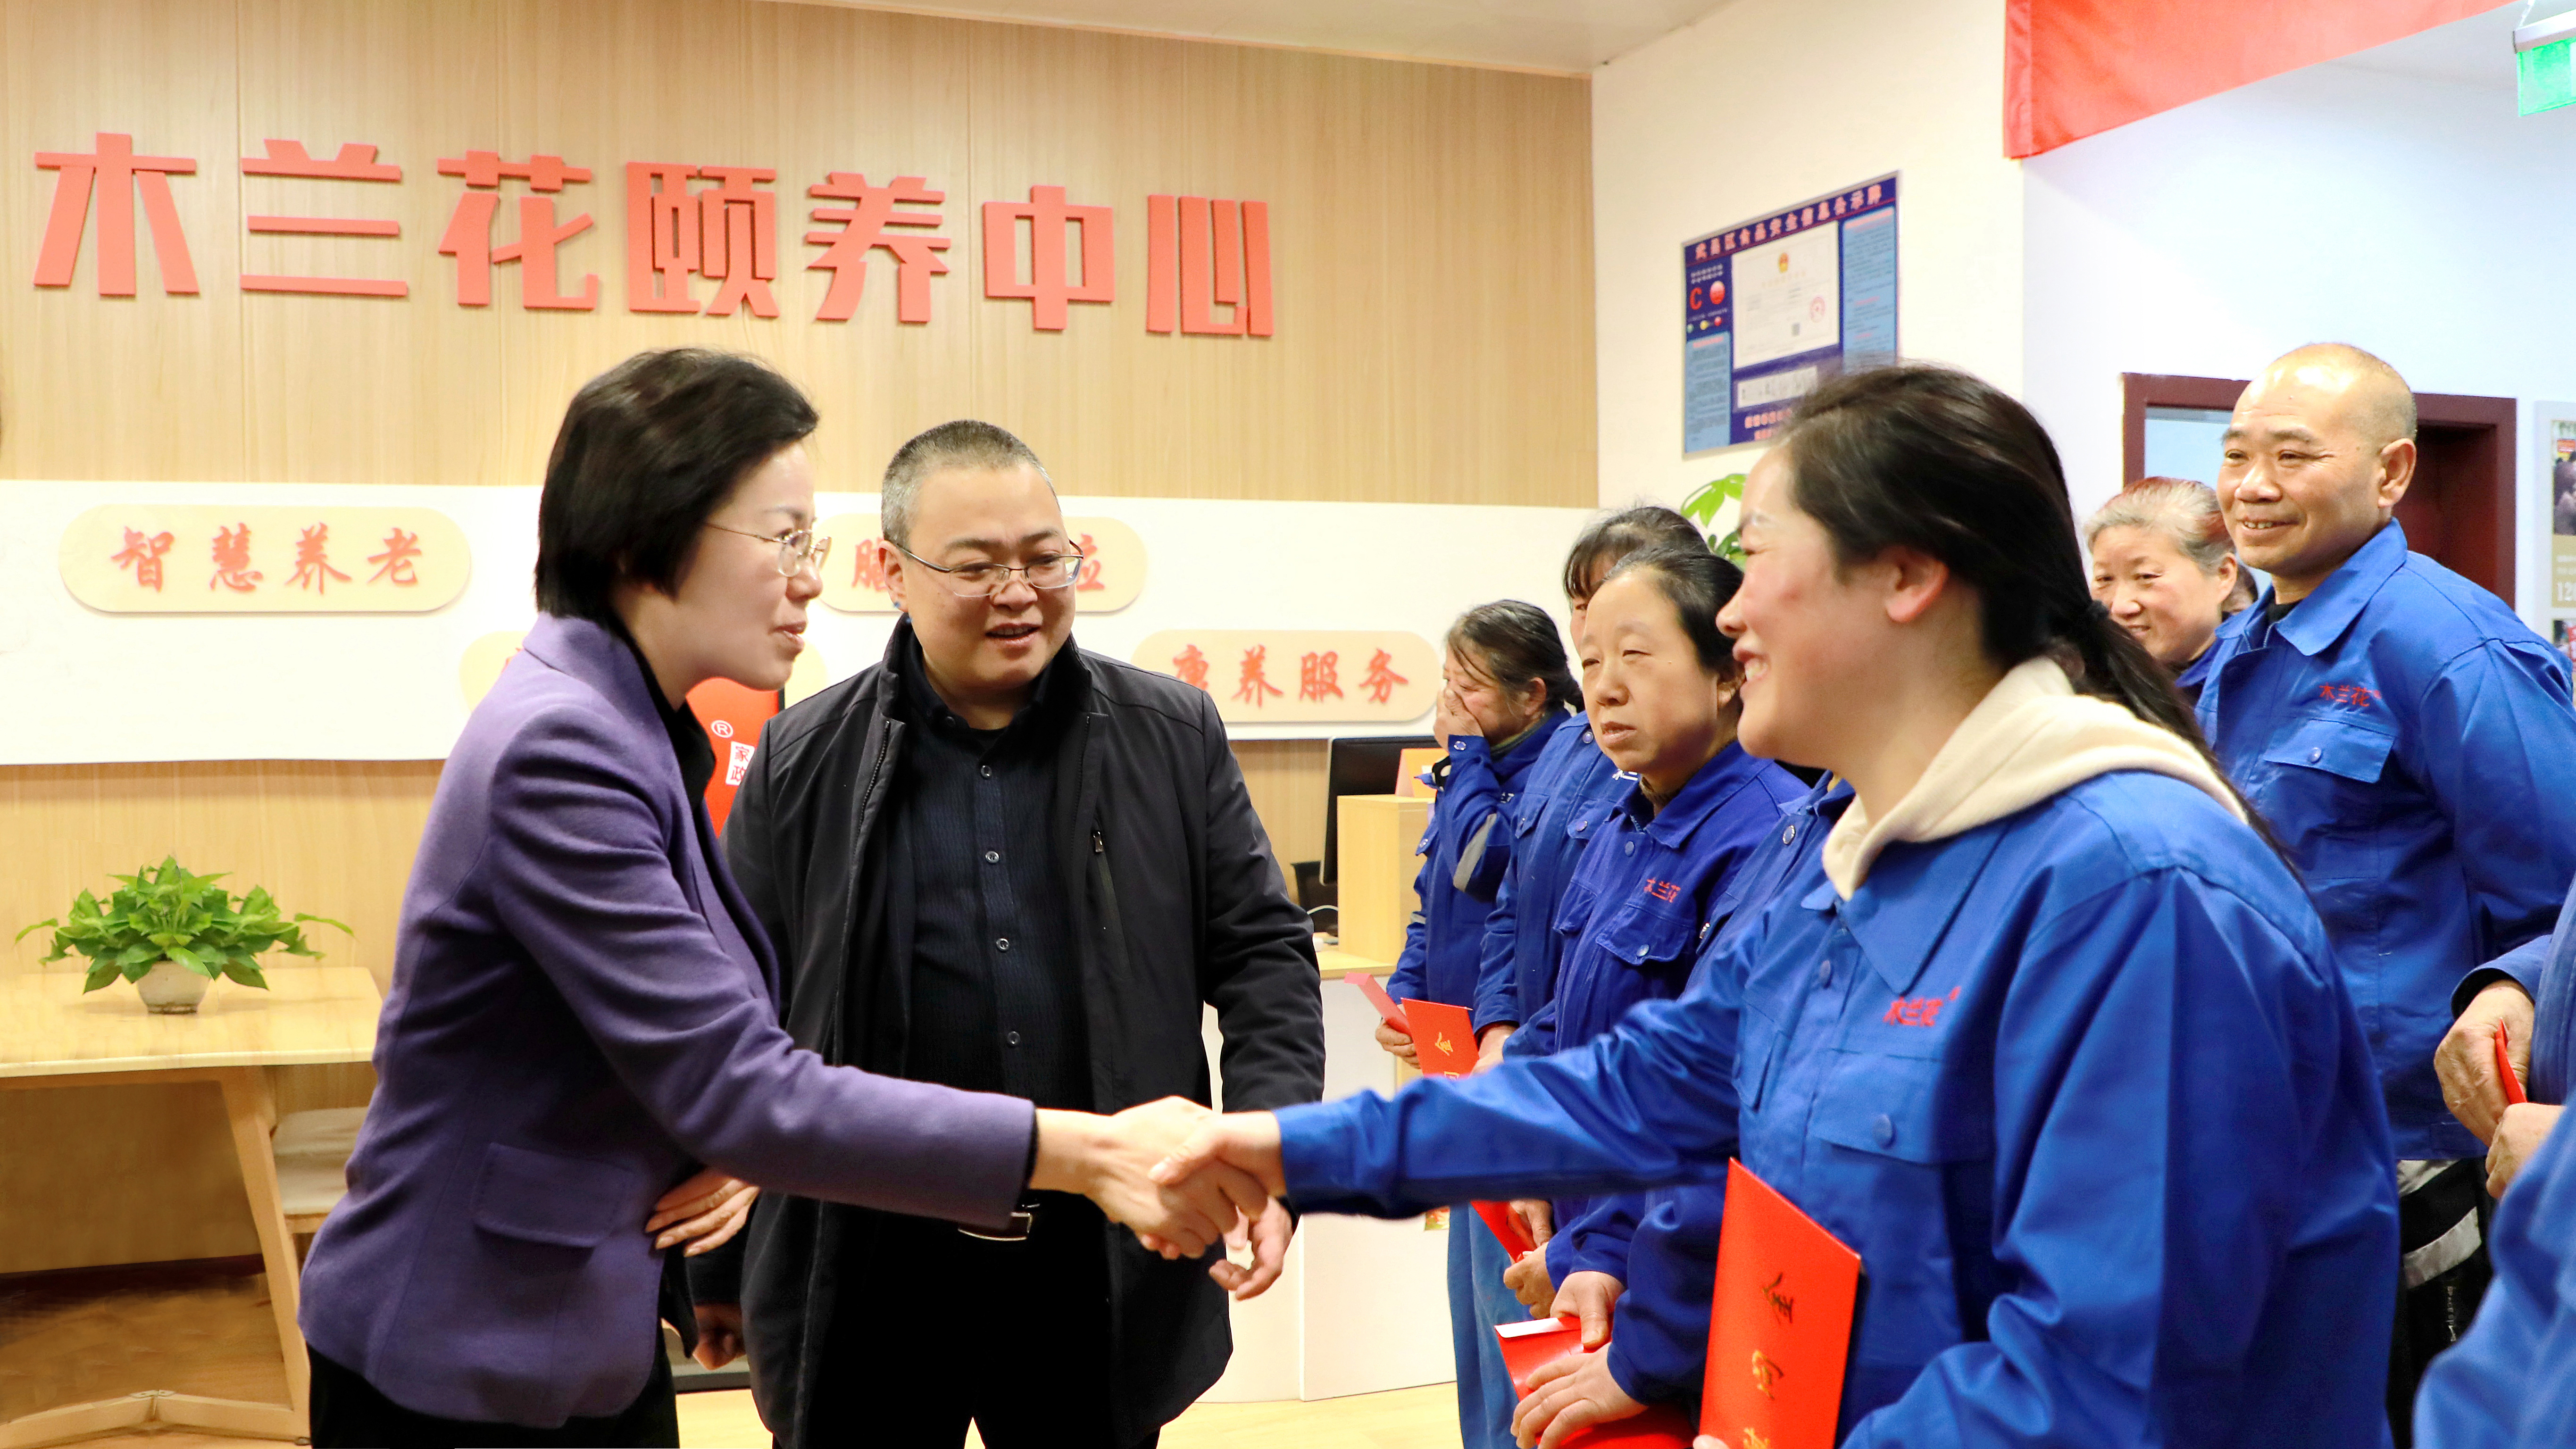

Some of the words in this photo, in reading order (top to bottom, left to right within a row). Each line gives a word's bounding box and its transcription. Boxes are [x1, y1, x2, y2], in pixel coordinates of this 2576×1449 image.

[34, 133, 1275, 338] 木兰花颐养中心
[1689, 287, 1703, 310] C
[111, 522, 423, 594] 智慧养老
[1172, 643, 1409, 708] 康养服务
[2318, 682, 2373, 707] 木兰花
